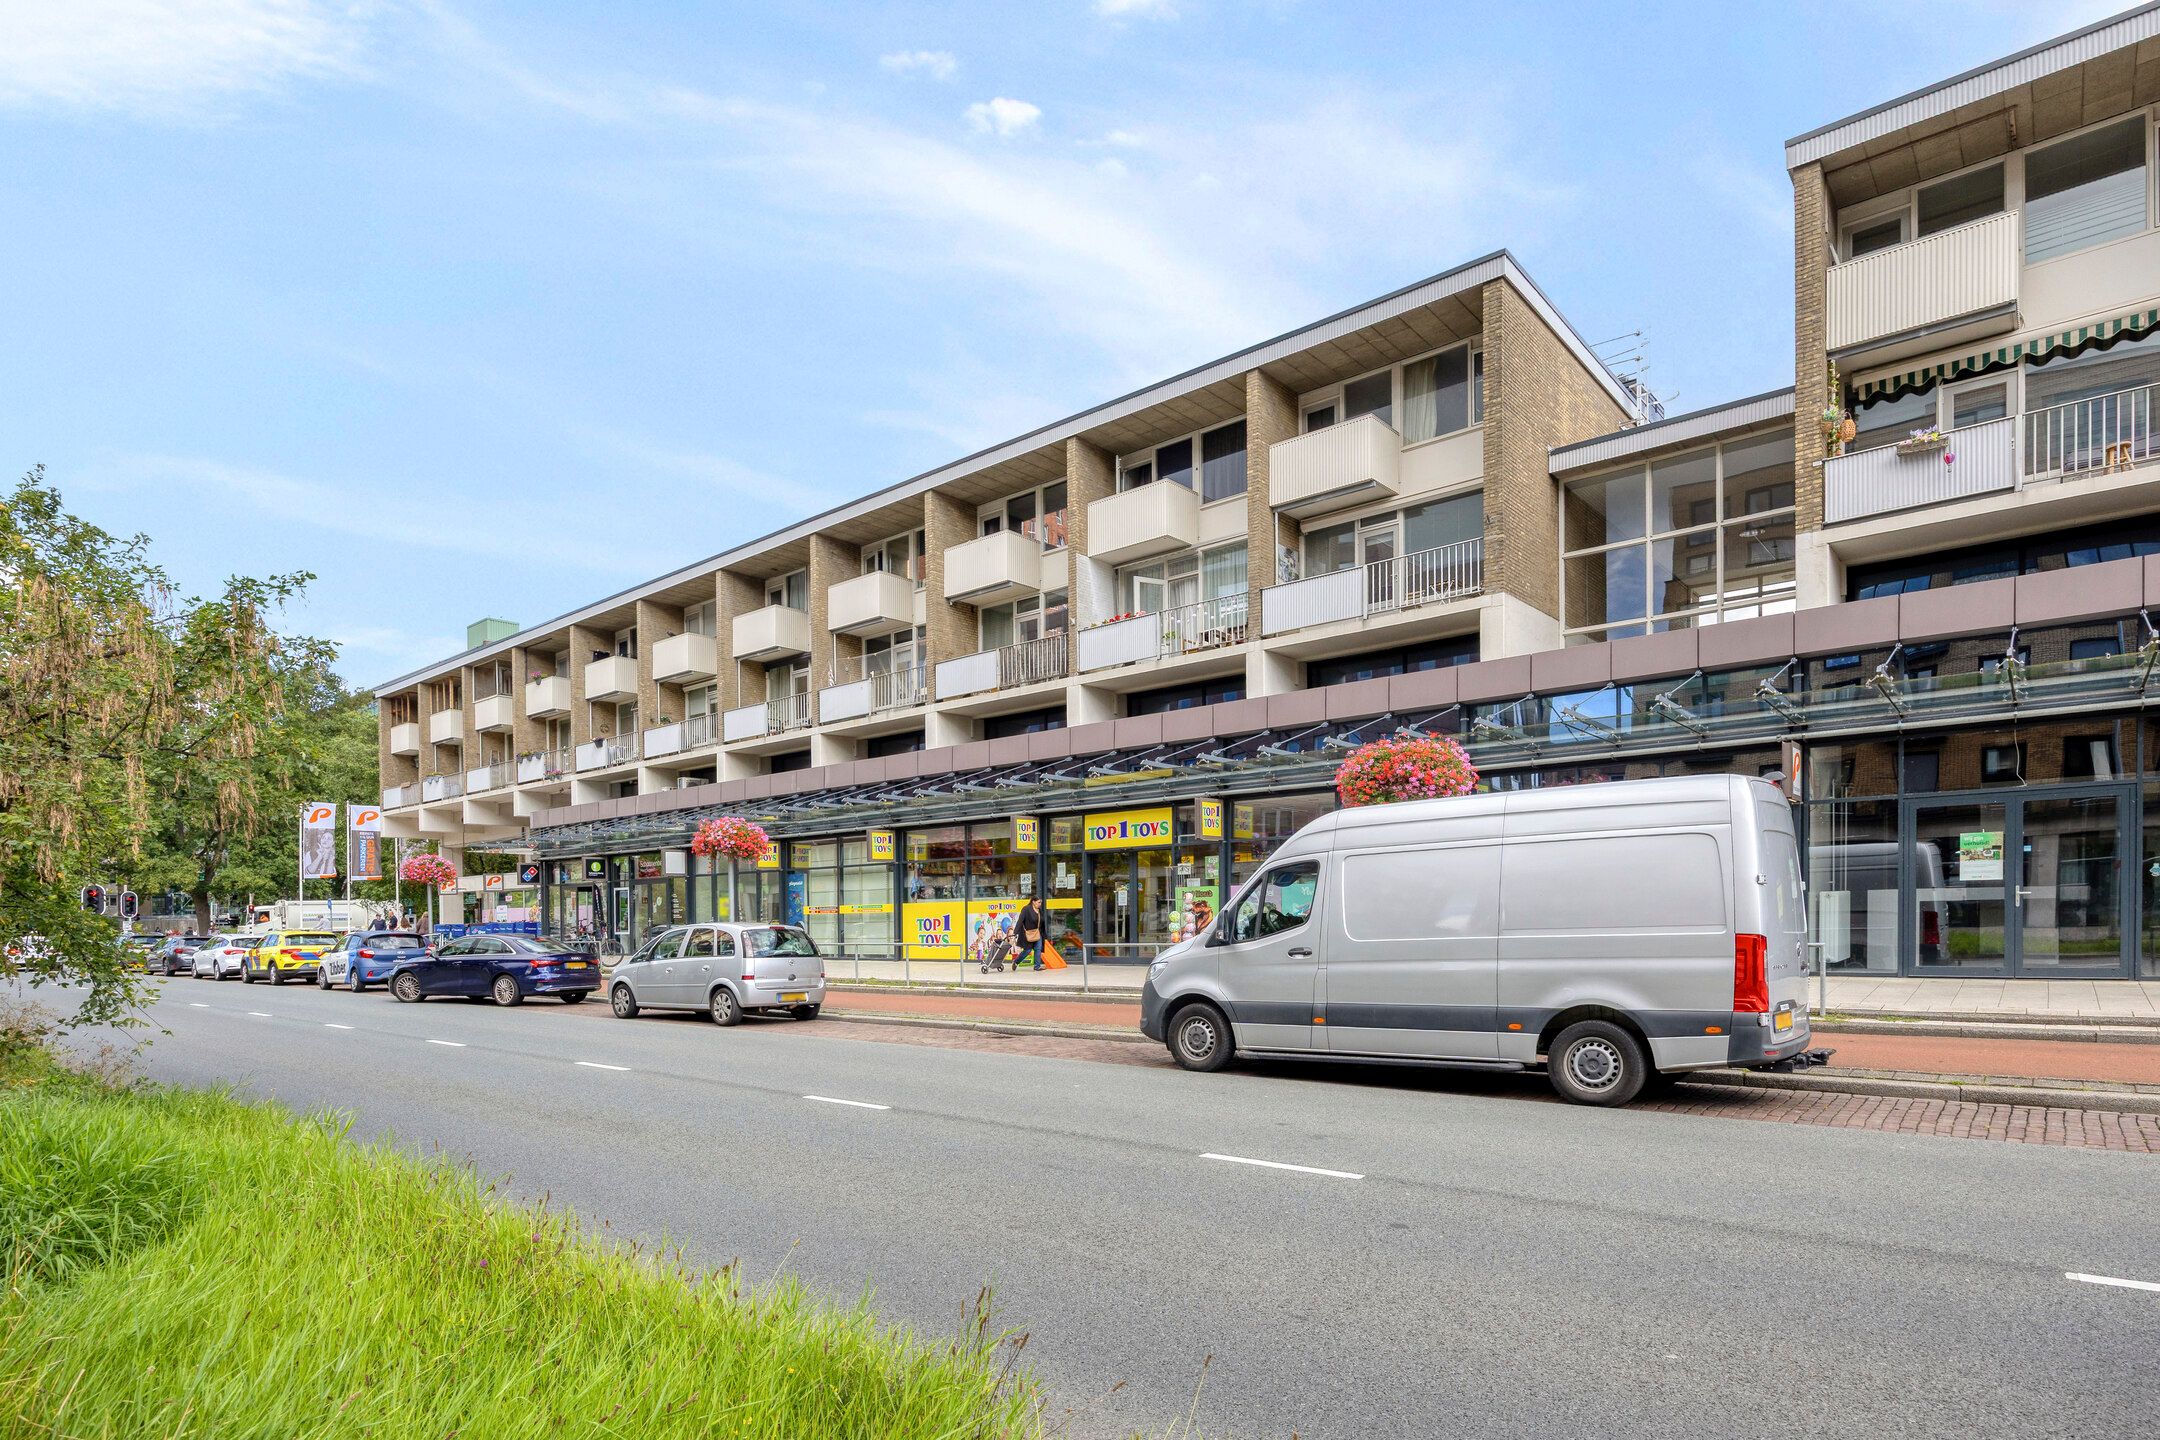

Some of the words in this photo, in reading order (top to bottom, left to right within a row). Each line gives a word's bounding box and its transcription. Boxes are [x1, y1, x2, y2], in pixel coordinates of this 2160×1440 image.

[1203, 807, 1216, 816] TOP
[1216, 806, 1220, 817] 1
[1018, 823, 1031, 832] TOP
[1032, 821, 1036, 832] 1
[1204, 818, 1219, 828] TOYS
[1088, 825, 1117, 841] TOP
[1118, 820, 1129, 839] 1
[1130, 821, 1169, 837] TOYS
[873, 836, 887, 844] TOP
[887, 834, 893, 844] 1
[1019, 833, 1035, 842] TOYS
[917, 918, 941, 931] TOP
[942, 914, 951, 931] 1
[919, 934, 950, 947] TOYS
